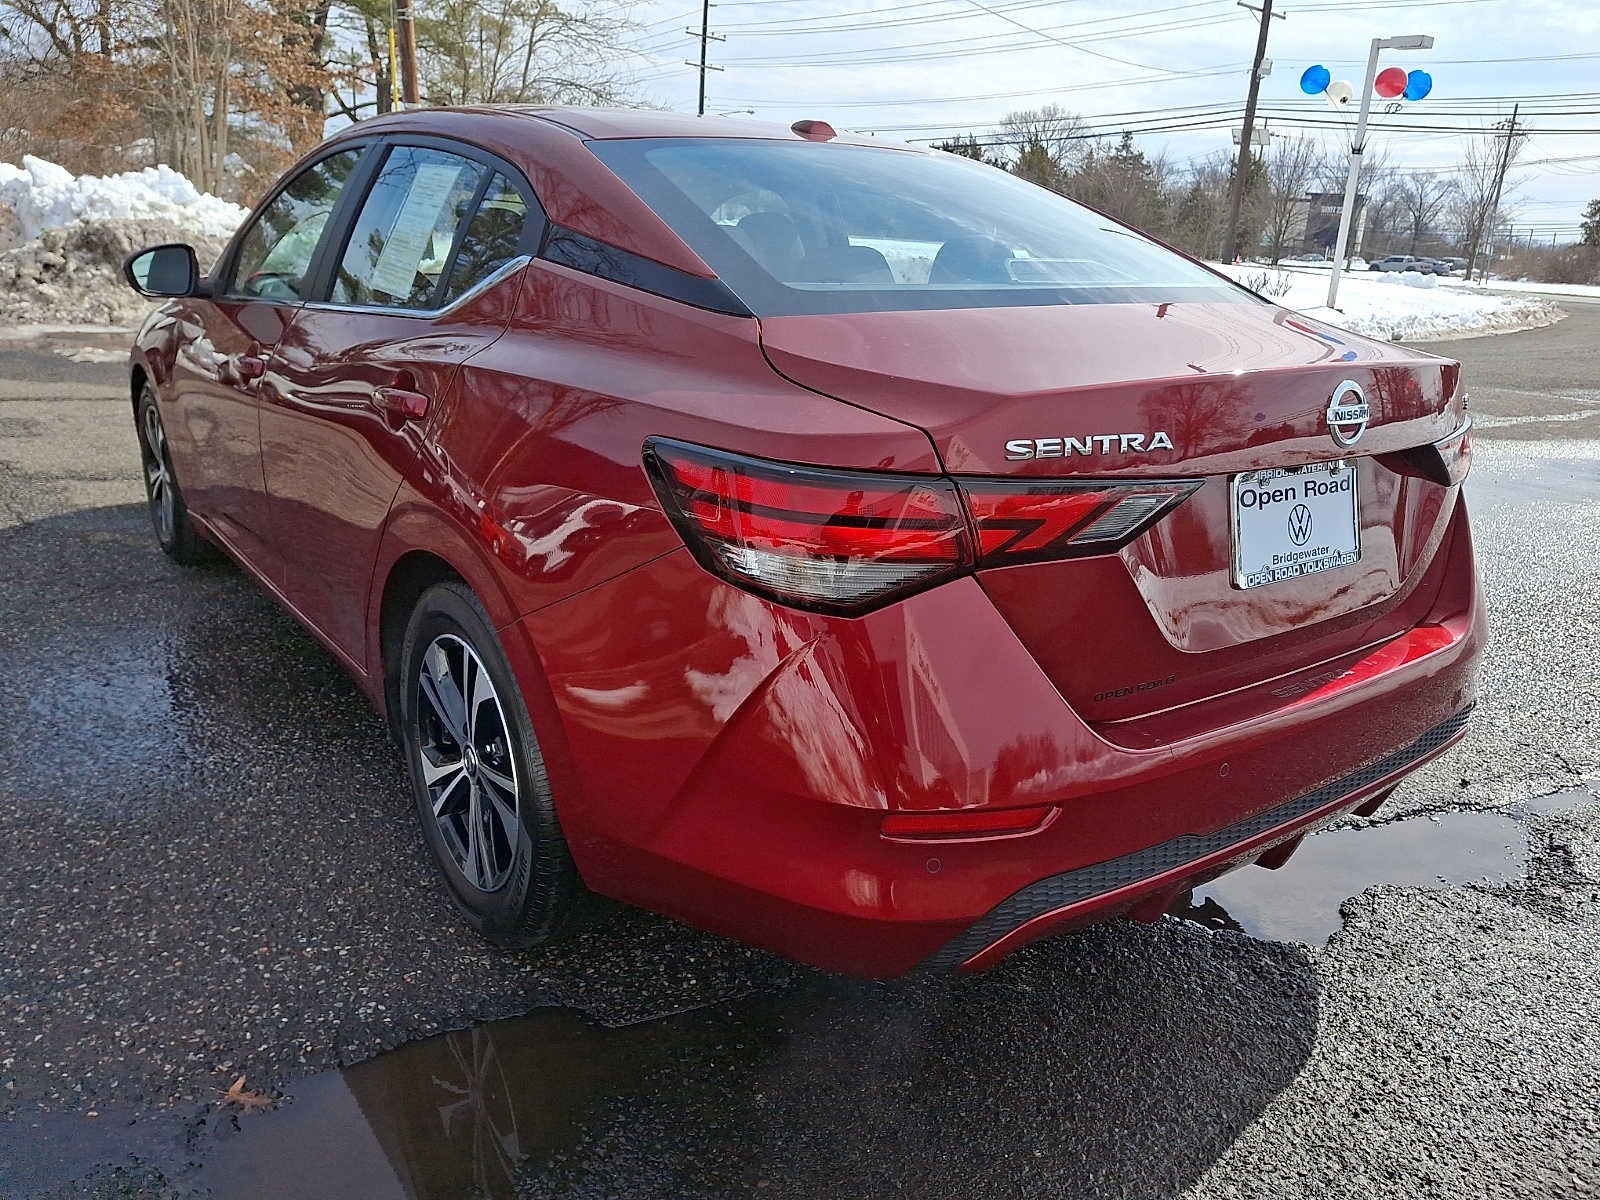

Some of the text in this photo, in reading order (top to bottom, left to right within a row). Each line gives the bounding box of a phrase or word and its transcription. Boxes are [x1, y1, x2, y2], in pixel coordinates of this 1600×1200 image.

[1335, 409, 1369, 421] NISSAN
[1005, 431, 1174, 460] SENTRA
[1240, 475, 1350, 510] Open Road
[1273, 546, 1329, 564] Bridgewater
[1247, 551, 1357, 587] OPEN ROAD VOLKSWAGEN
[1094, 686, 1133, 702] OPEN
